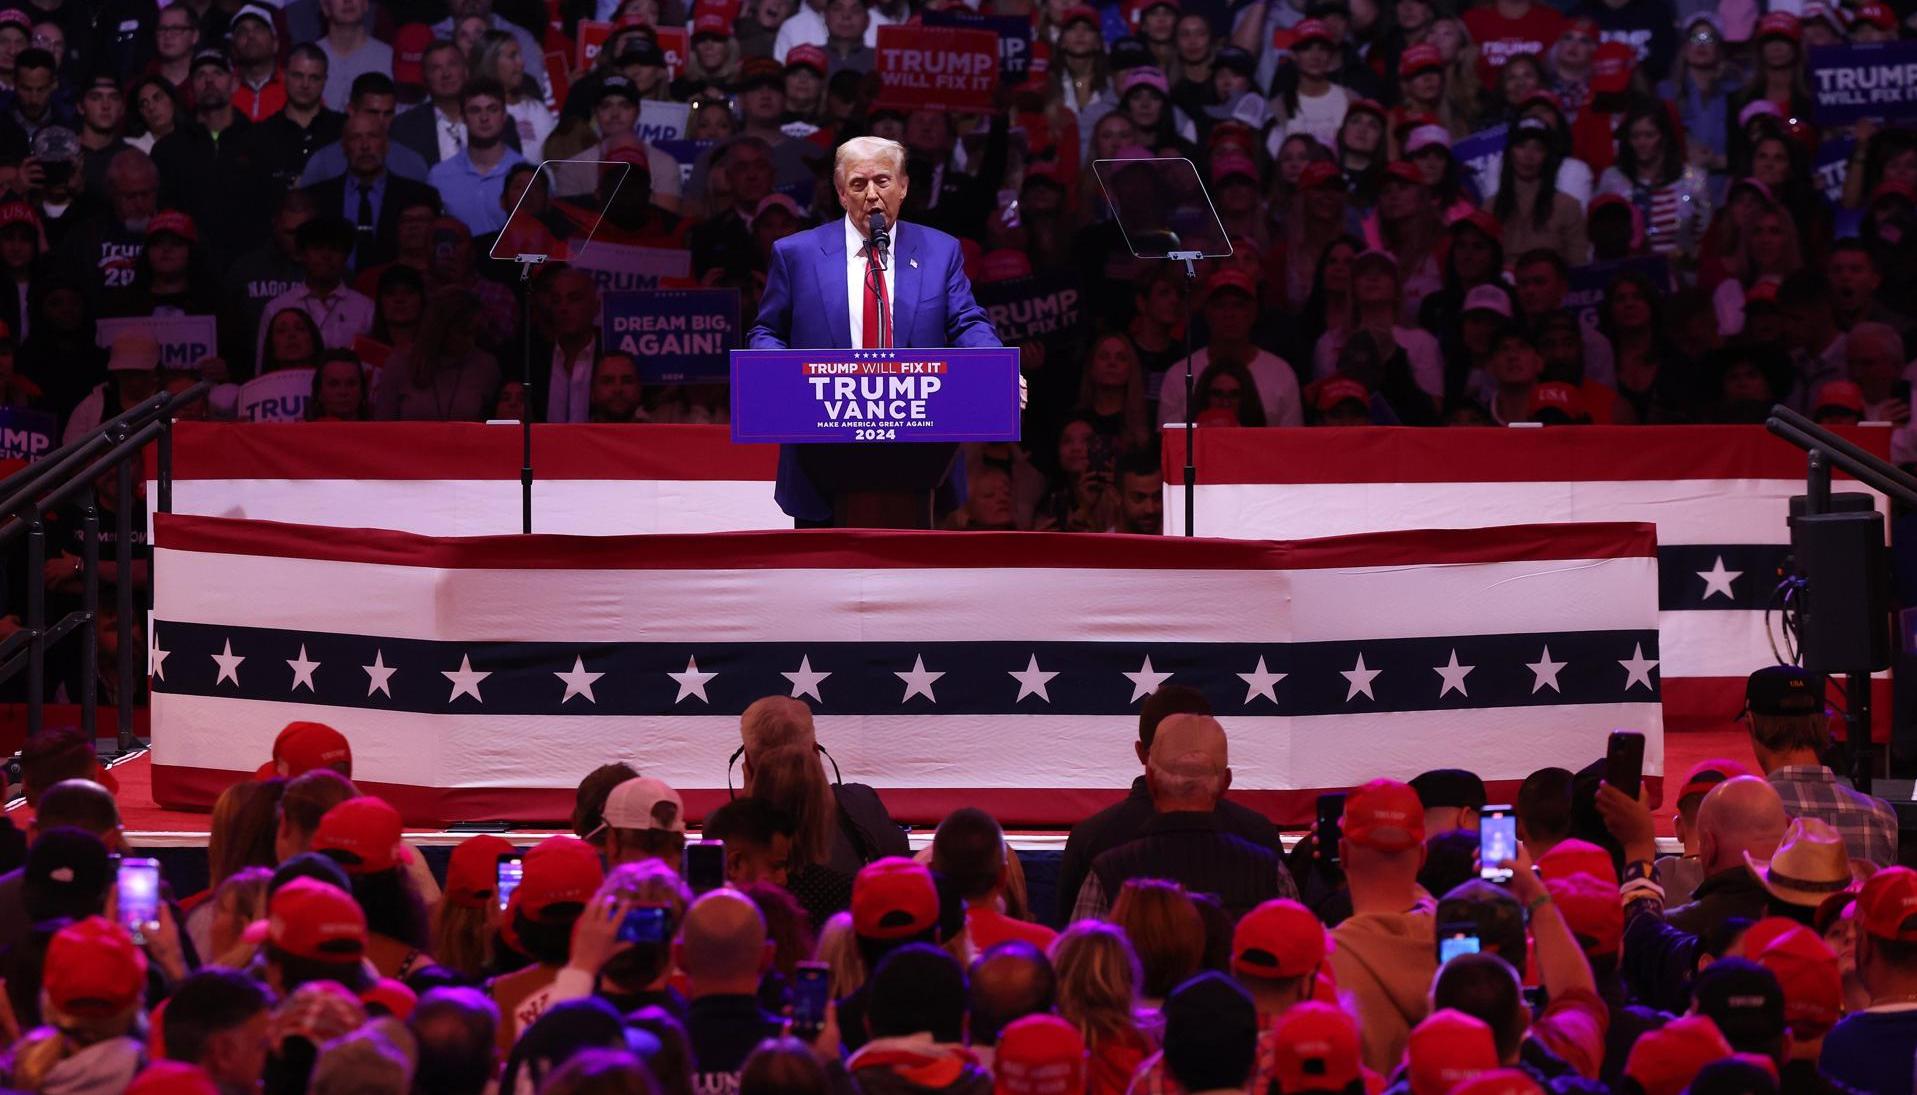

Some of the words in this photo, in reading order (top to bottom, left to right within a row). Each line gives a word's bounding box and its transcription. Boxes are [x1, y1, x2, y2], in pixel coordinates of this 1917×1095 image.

[881, 49, 993, 74] TRUMP
[882, 73, 929, 88] WILL
[936, 75, 967, 89] FIX
[973, 77, 992, 90] IT
[1818, 91, 1865, 105] WILL
[1871, 88, 1901, 102] FIX
[988, 288, 1079, 325] RUMP
[613, 316, 686, 332] DREAM
[692, 314, 732, 331] BIG,
[620, 333, 723, 356] AGAIN!
[809, 363, 858, 374] TRUMP
[862, 363, 897, 374] WILL
[901, 362, 924, 373] FIX
[928, 362, 941, 373] IT
[808, 376, 942, 400] TRUMP
[823, 400, 926, 419] VANCE
[855, 429, 896, 440] 2024
